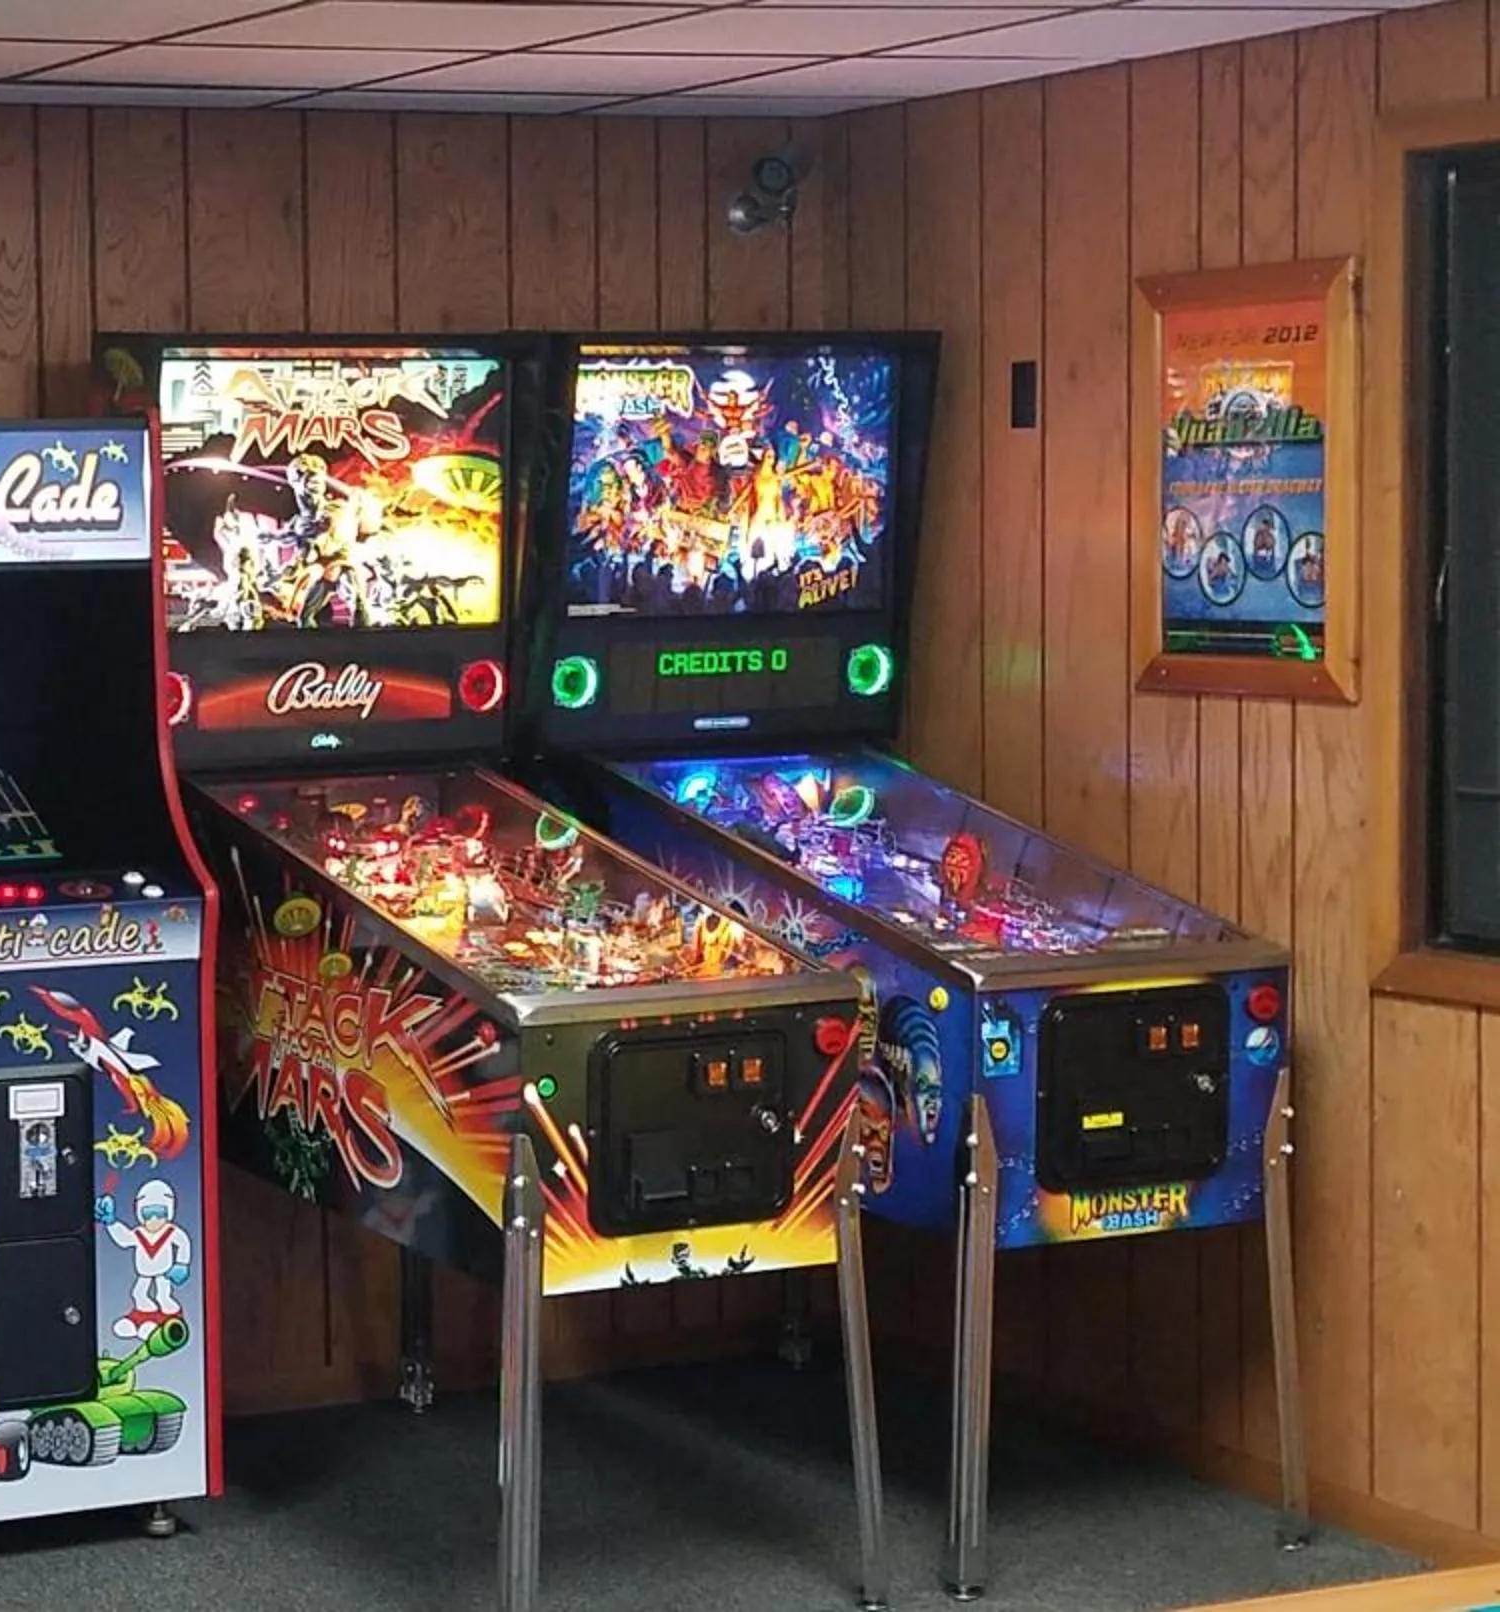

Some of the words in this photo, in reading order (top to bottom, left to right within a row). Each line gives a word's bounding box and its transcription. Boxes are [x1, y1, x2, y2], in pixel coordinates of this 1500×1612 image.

[1263, 324, 1319, 345] 2012
[229, 408, 412, 471] MARS
[659, 651, 764, 676] CREDITS
[266, 661, 384, 721] Bally
[1072, 1184, 1188, 1231] MONSTER
[1103, 1211, 1159, 1231] BASH
